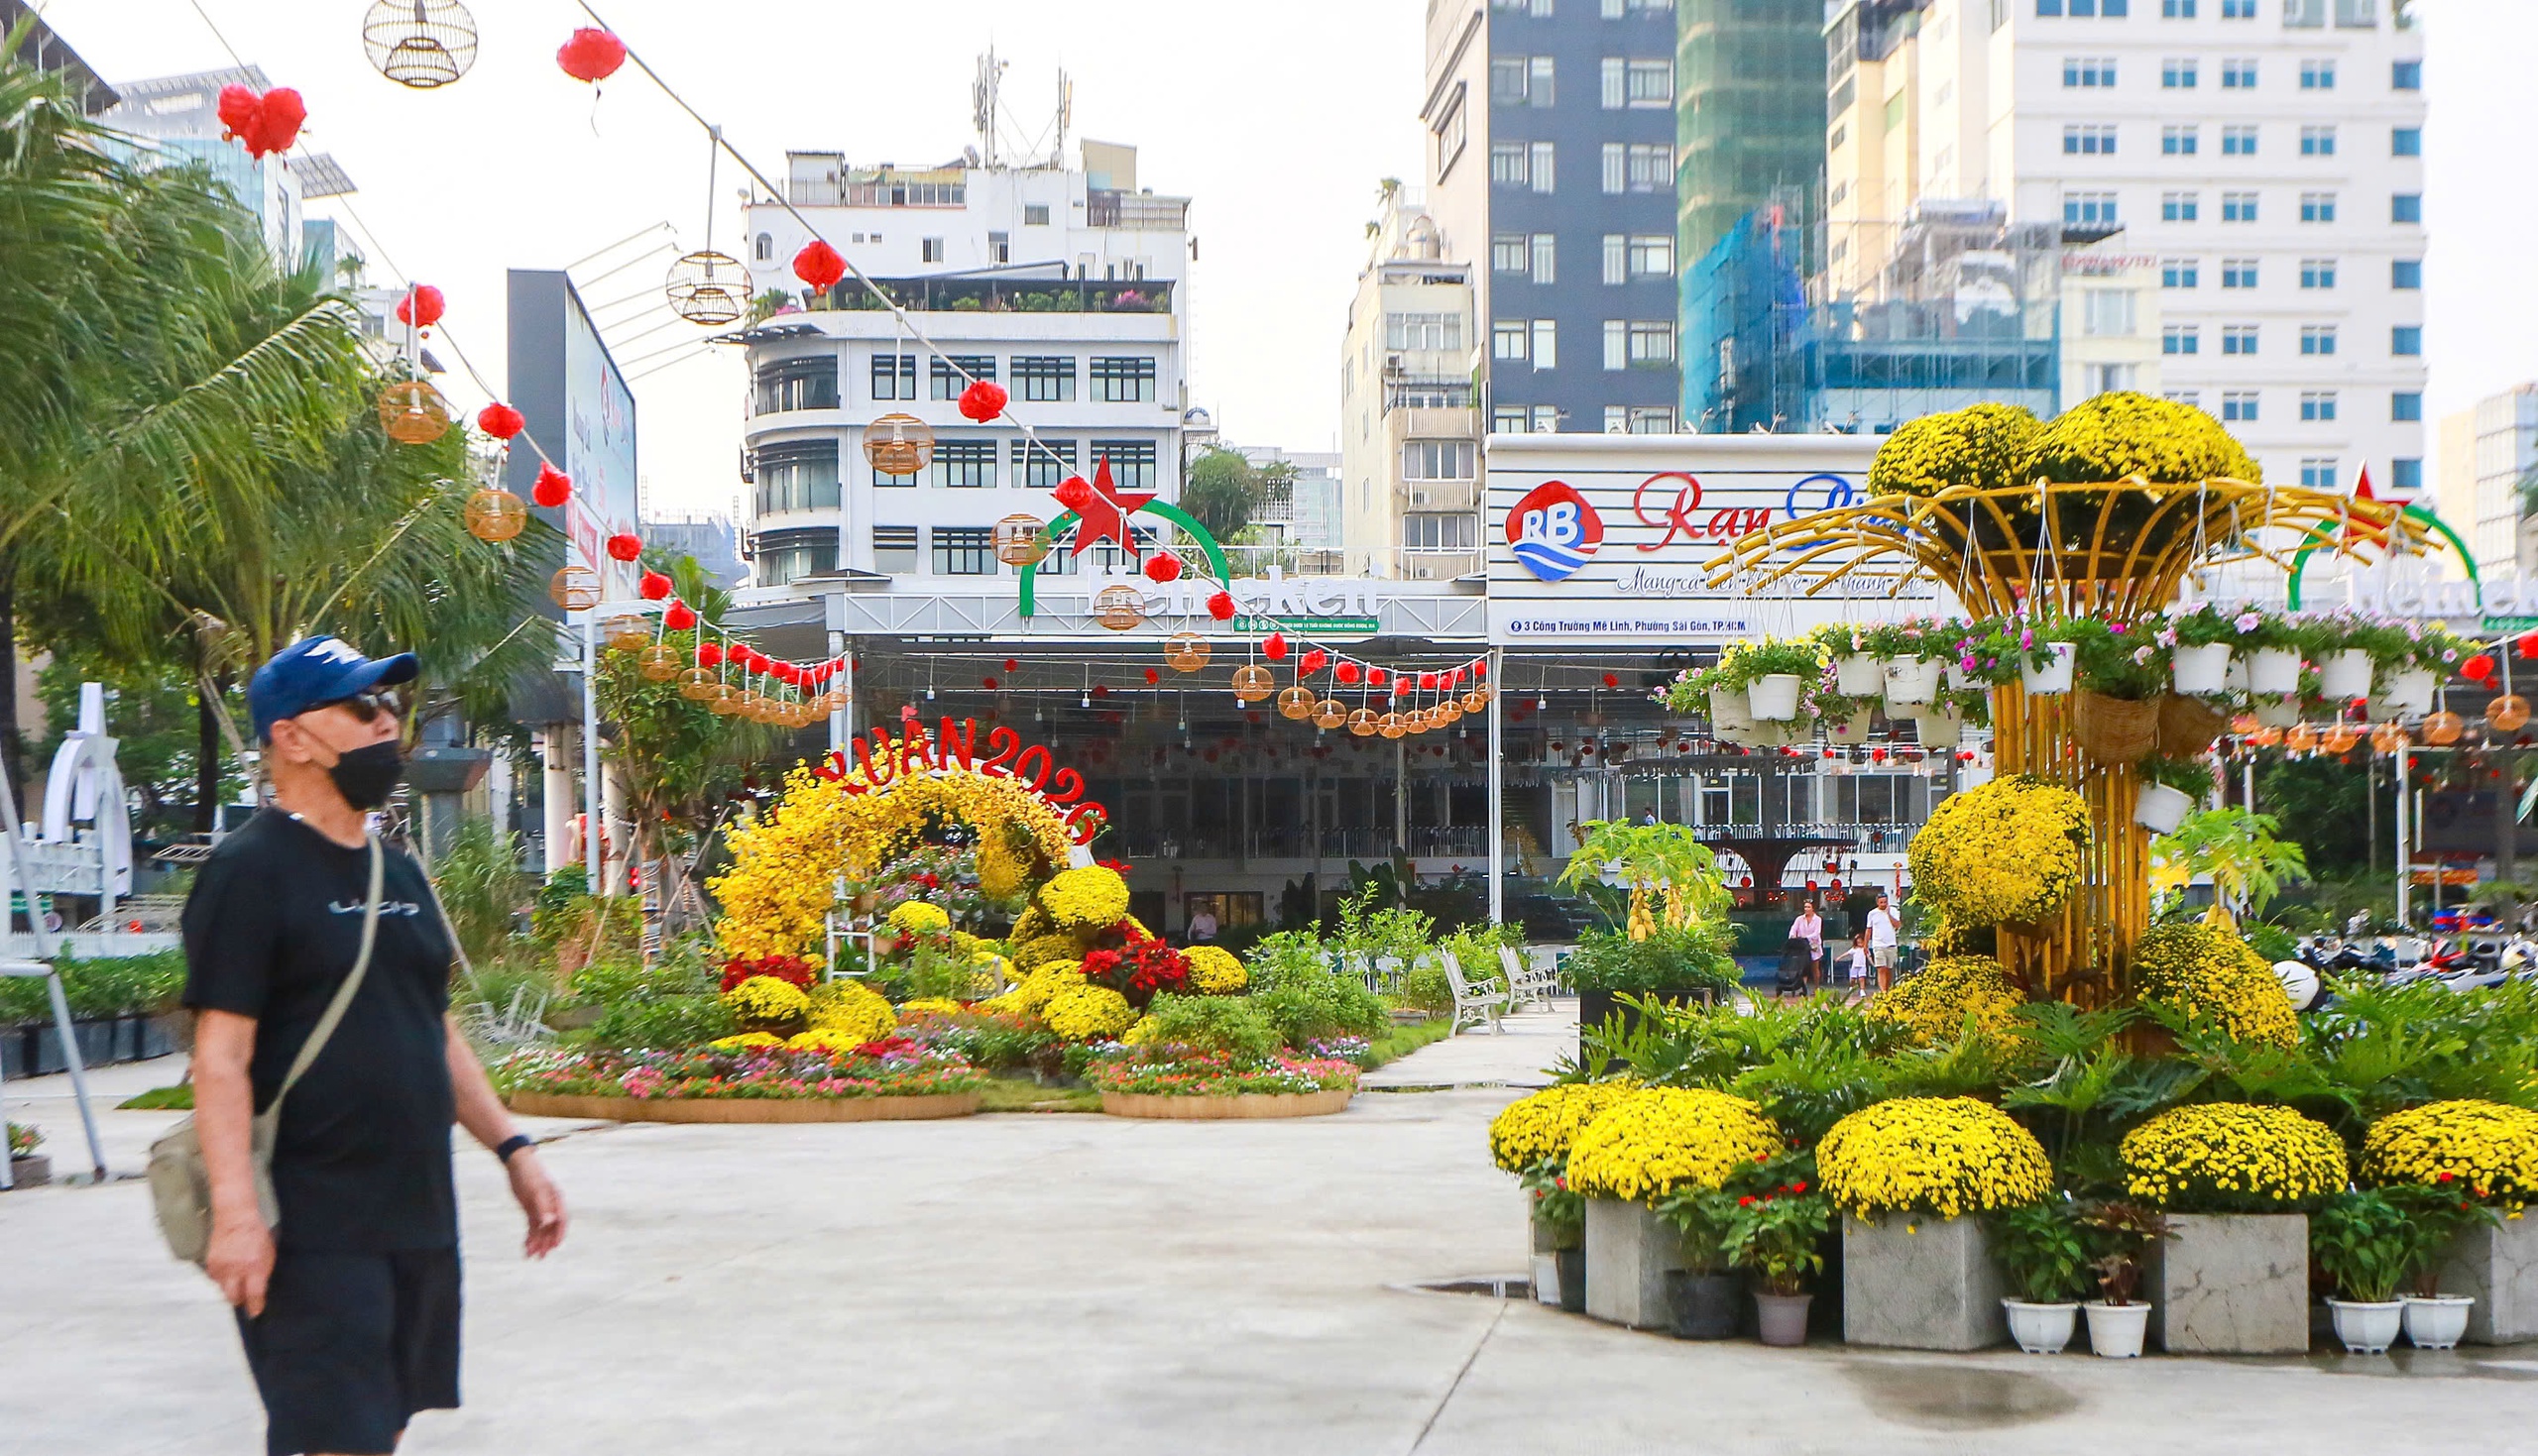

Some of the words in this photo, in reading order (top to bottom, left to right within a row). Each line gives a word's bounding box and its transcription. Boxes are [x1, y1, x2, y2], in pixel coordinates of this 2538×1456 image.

[1522, 501, 1581, 545] RB
[1616, 564, 1677, 597] Mang
[1679, 572, 1701, 591] cá
[1524, 620, 1531, 631] 3
[1533, 619, 1557, 632] Công
[1593, 619, 1608, 631] Mê
[1610, 620, 1633, 632] Linh,
[1673, 619, 1687, 631] Sài
[981, 726, 1107, 846] 2026
